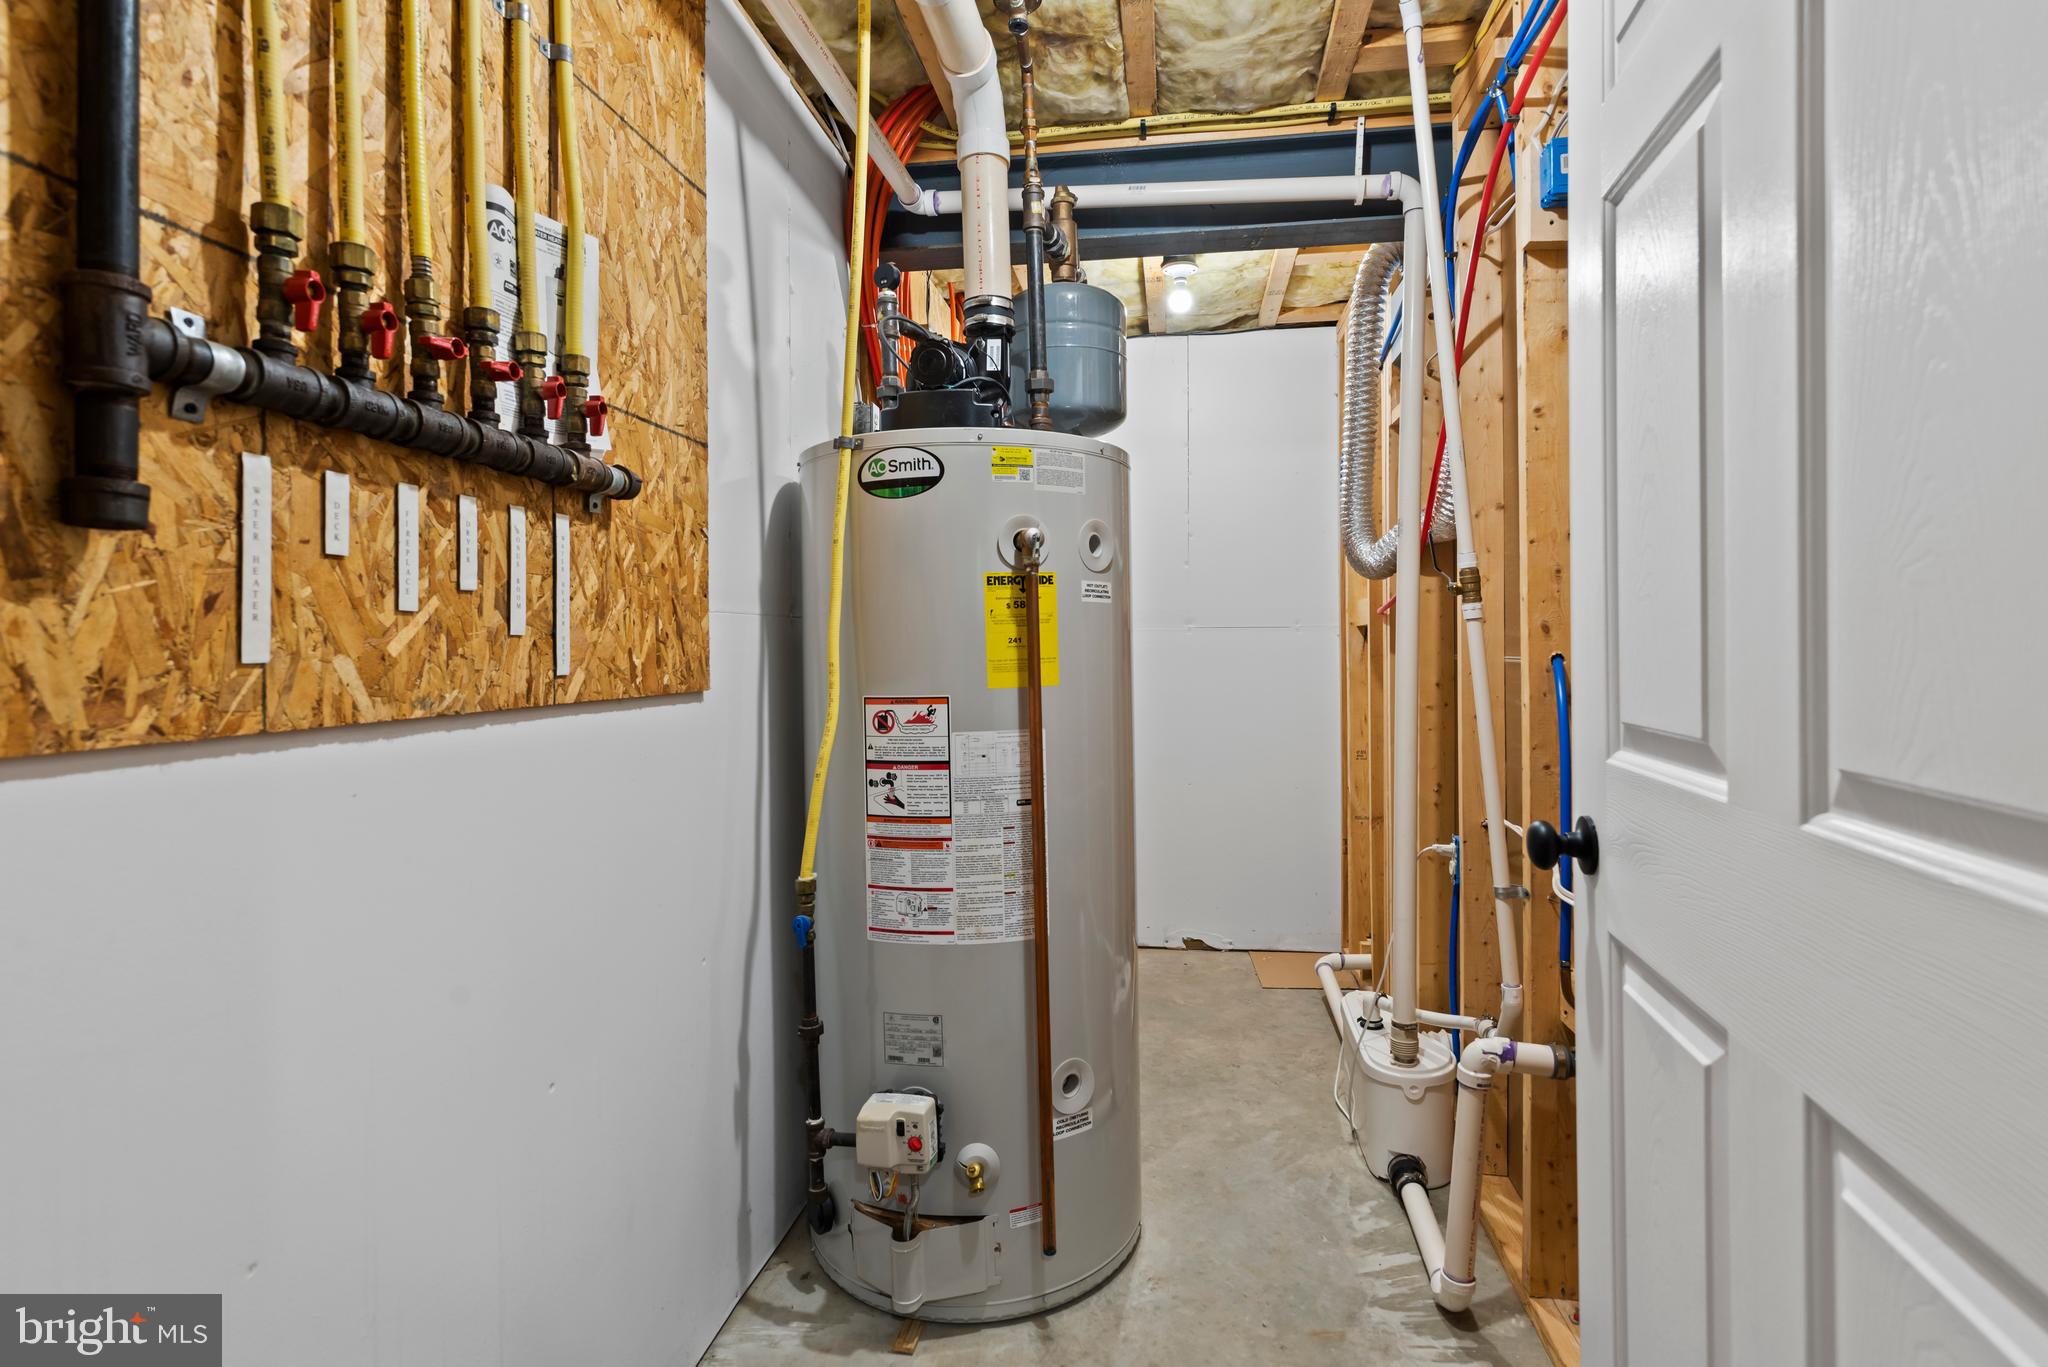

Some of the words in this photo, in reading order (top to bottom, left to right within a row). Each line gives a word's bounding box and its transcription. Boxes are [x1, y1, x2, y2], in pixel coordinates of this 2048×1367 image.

[126, 313, 142, 357] WARD
[888, 457, 931, 473] Smith
[252, 486, 260, 540] WATER
[251, 555, 260, 621] HEATER
